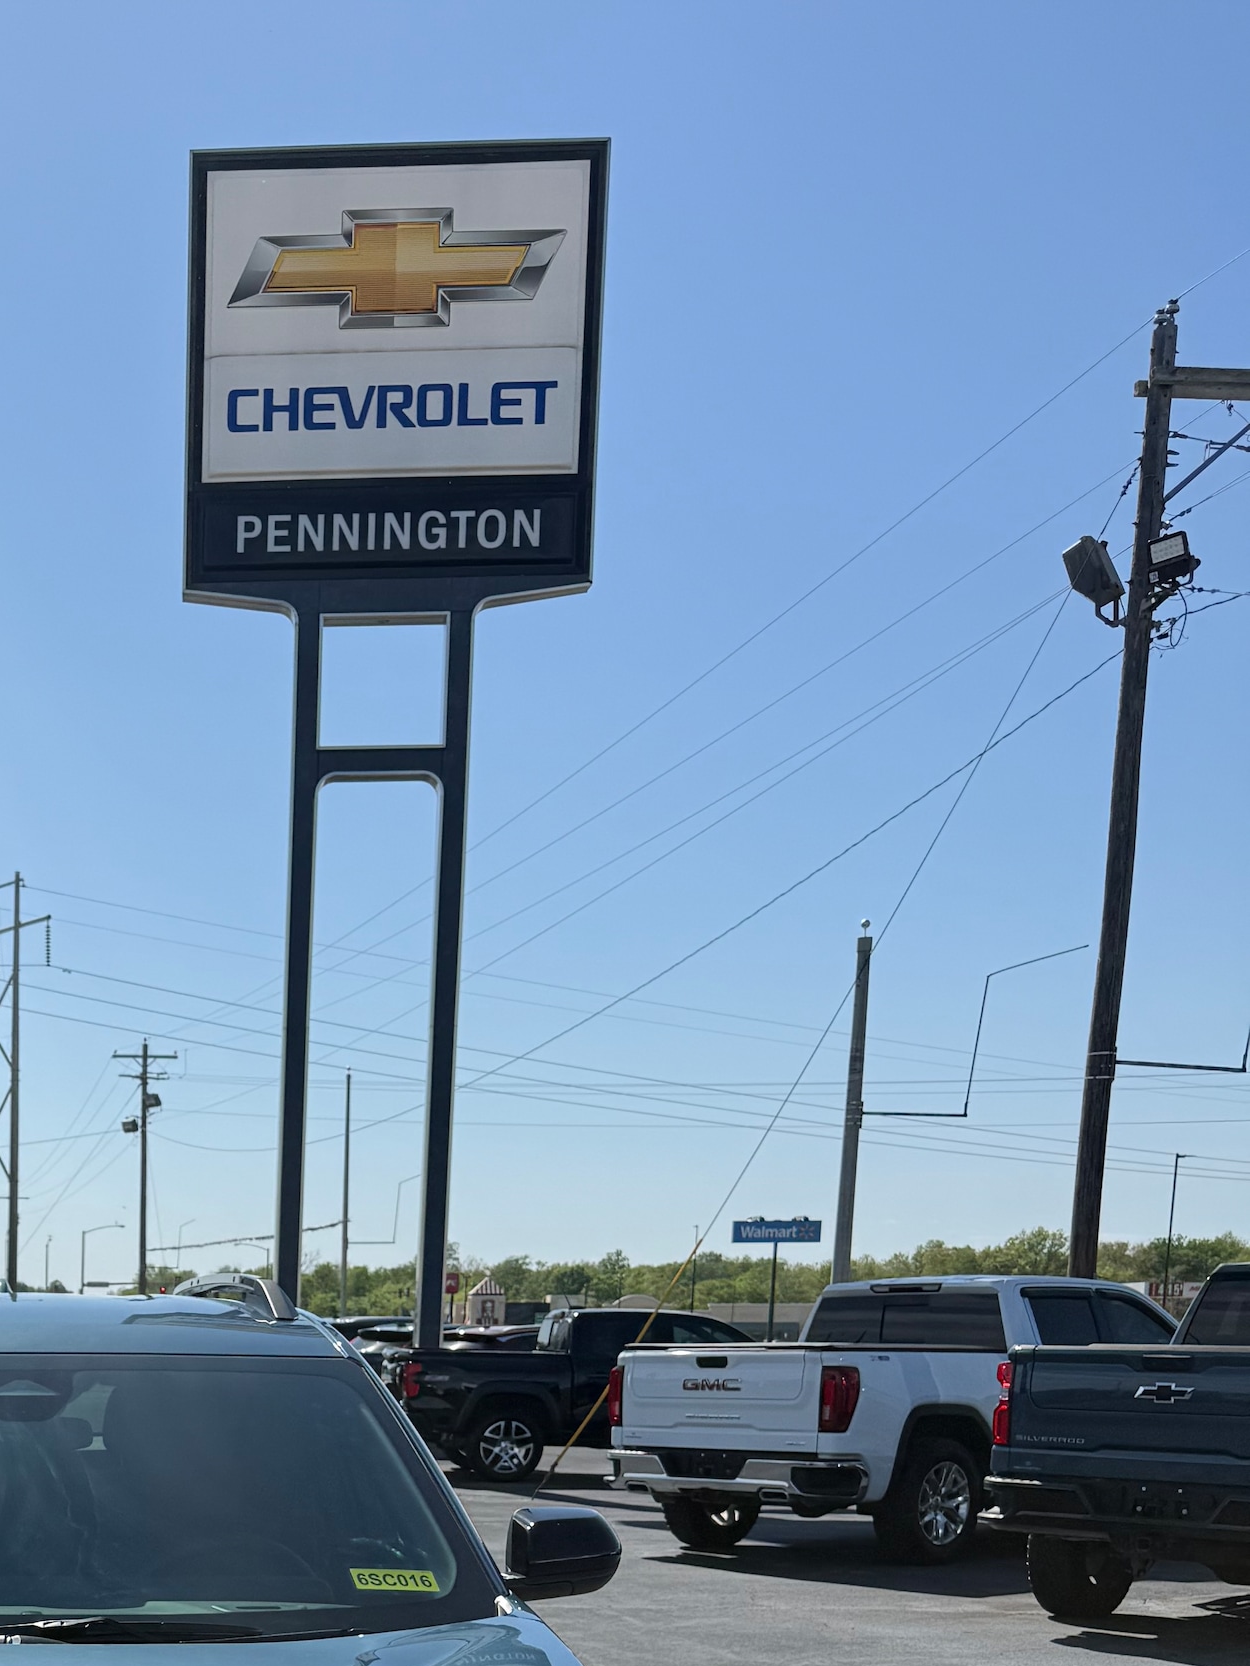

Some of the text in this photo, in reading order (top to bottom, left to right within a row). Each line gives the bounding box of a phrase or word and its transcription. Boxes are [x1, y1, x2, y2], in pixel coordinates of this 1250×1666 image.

[227, 380, 558, 433] CHEVROLET
[236, 508, 542, 553] PENNINGTON
[740, 1225, 798, 1239] Walmart
[682, 1378, 742, 1392] GMC
[1015, 1434, 1085, 1445] SILVERADO
[356, 1573, 433, 1588] 6SC016
